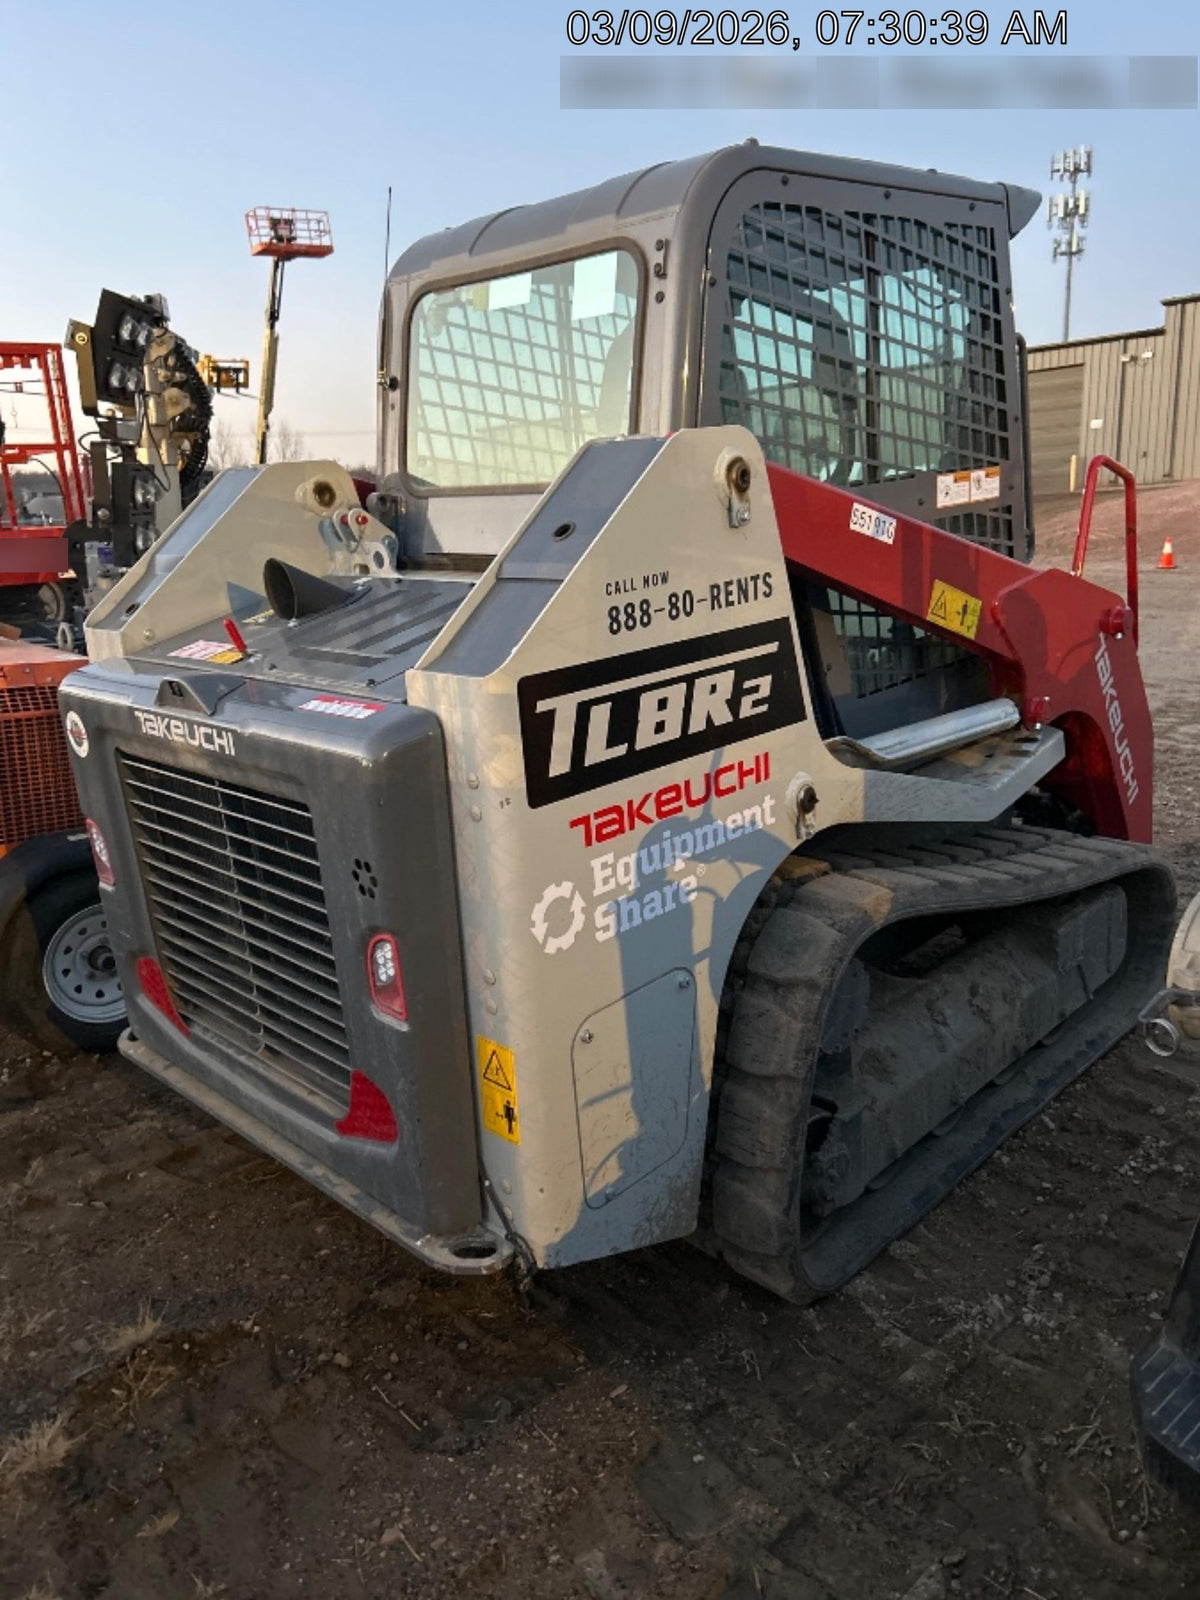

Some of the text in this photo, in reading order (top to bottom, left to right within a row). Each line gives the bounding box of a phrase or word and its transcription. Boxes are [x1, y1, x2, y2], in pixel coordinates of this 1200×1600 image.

[605, 571, 669, 596] CALL NOW
[607, 572, 773, 635] 888-80-RENTS
[134, 711, 236, 756] TAKEUCHI
[535, 641, 780, 778] TL8R2
[1094, 631, 1139, 805] TAKEUCHI
[569, 751, 770, 848] TAKEUCHI
[590, 794, 776, 896] Equipment
[594, 874, 698, 942] Share
